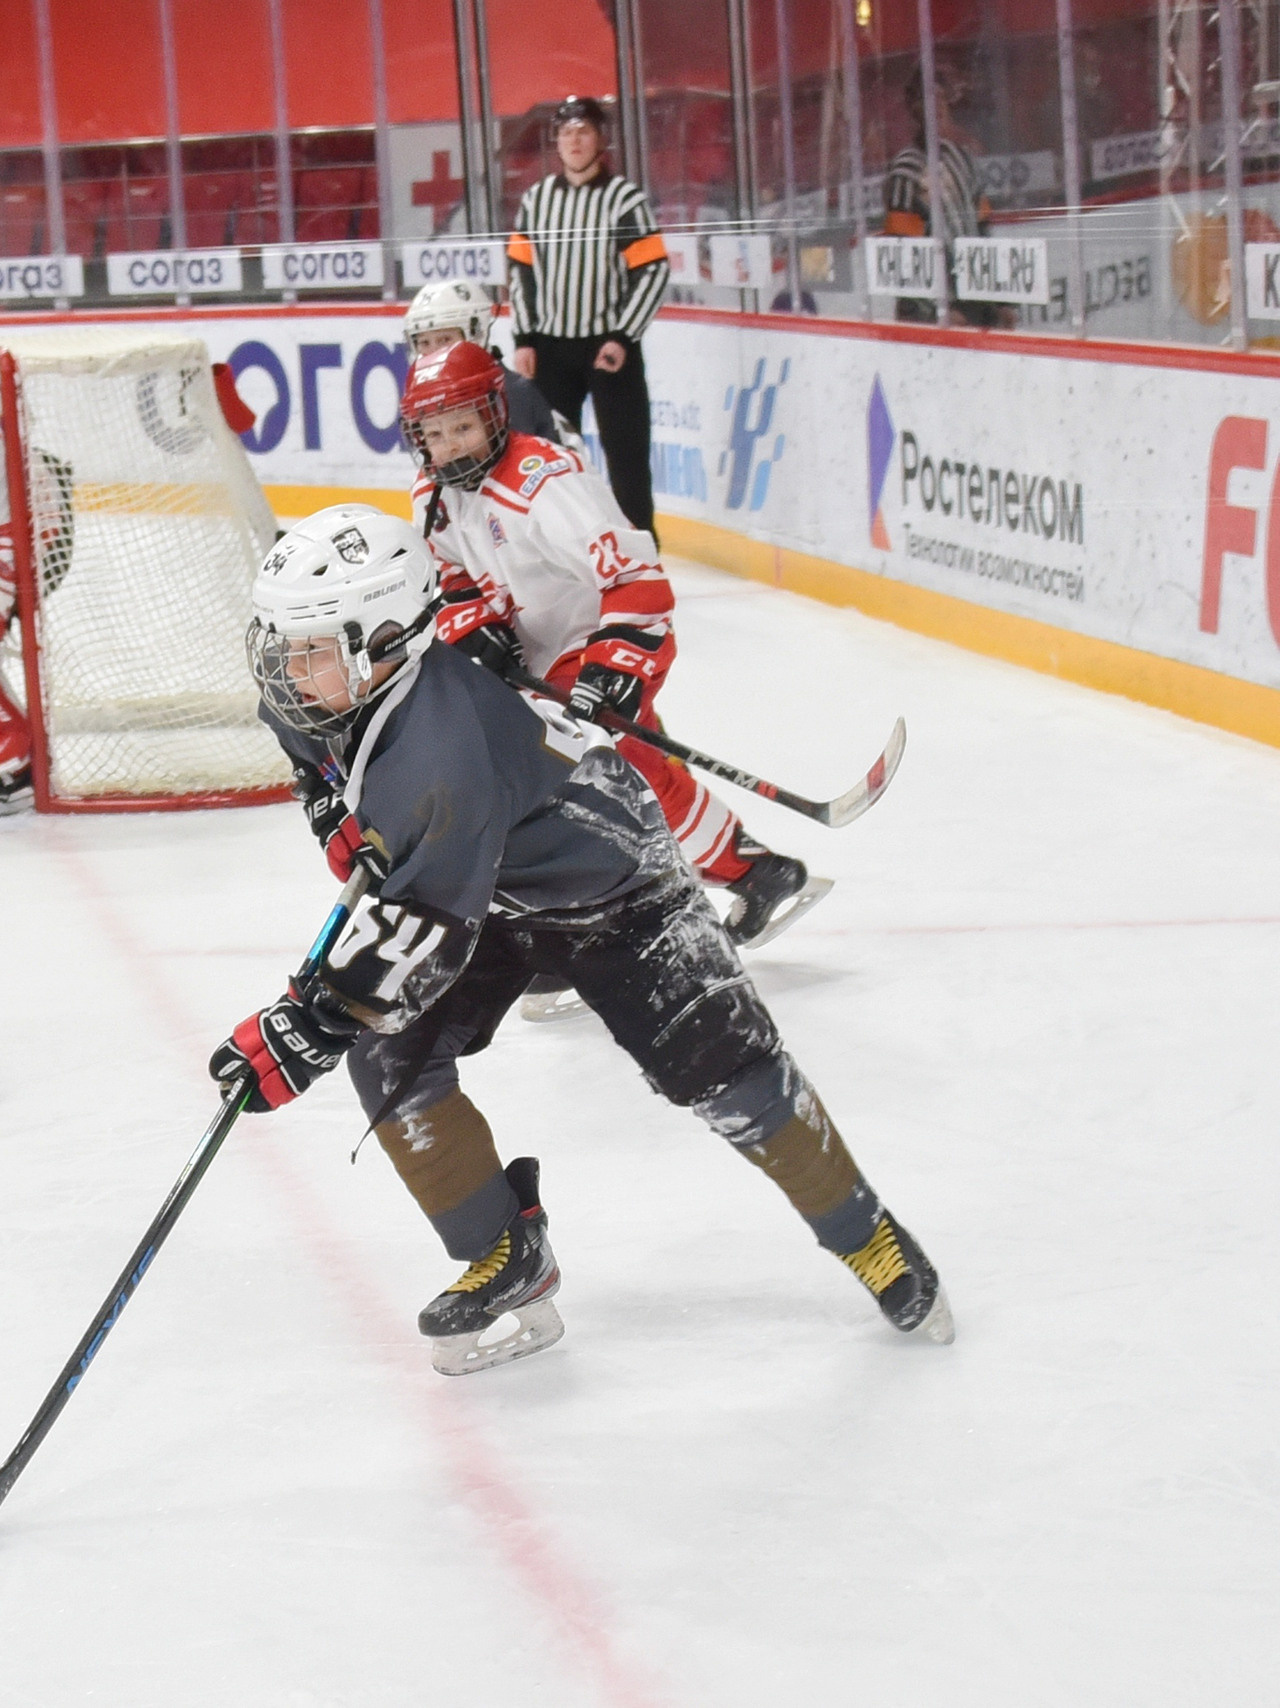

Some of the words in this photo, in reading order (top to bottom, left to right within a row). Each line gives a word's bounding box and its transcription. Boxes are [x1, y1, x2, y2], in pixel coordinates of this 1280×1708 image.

[128, 257, 223, 287] согаз
[283, 251, 366, 281] согаз
[420, 248, 491, 278] согаз
[900, 429, 1085, 546] Ростелеком
[1198, 414, 1280, 653] F
[363, 579, 407, 603] BAUER
[384, 626, 418, 653] BAUER
[269, 1012, 342, 1069] BAUE
